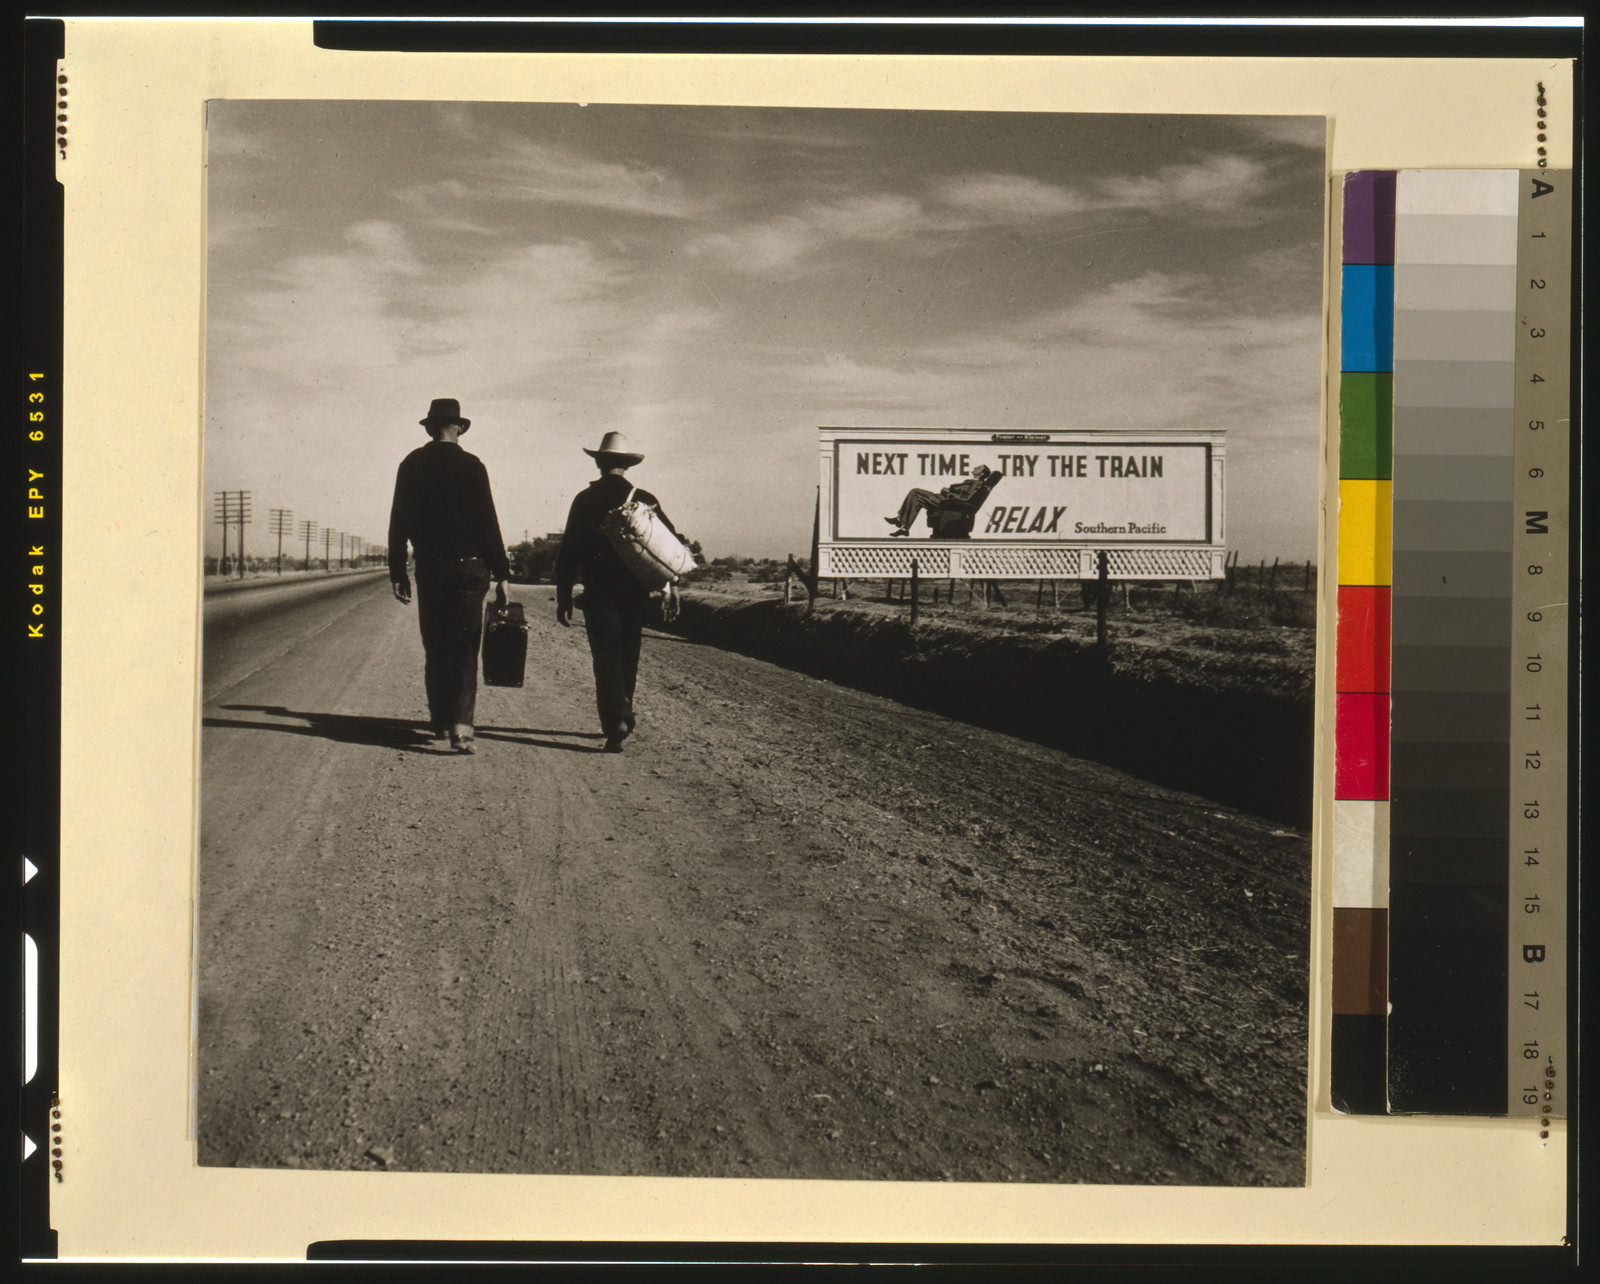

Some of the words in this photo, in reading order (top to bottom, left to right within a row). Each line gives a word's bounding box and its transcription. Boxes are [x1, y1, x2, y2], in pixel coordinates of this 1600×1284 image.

[1530, 178, 1554, 199] A
[1530, 279, 1546, 289] 2
[1530, 328, 1545, 338] 3
[1529, 374, 1545, 384] 4
[28, 374, 45, 441] 6531
[1529, 421, 1544, 431] 5
[857, 453, 908, 476] NEXT
[917, 453, 970, 476] TIME
[998, 455, 1039, 477] TRY
[1047, 455, 1088, 477] THE
[1096, 456, 1162, 478] TRAIN
[1529, 468, 1544, 478] 6
[28, 469, 44, 519] EPY
[984, 506, 1067, 534] RELAX
[1075, 521, 1126, 534] Southern
[1128, 521, 1166, 534] Pacific
[1526, 511, 1548, 534] M
[1528, 565, 1543, 575] 8
[28, 545, 44, 637] Kodak
[1527, 612, 1542, 622] 9
[1527, 653, 1542, 672] 10
[1526, 703, 1541, 720] 11
[1526, 750, 1541, 769] 12
[1524, 799, 1539, 819] 13
[1524, 847, 1539, 866] 14
[1524, 894, 1540, 913] 15
[1523, 945, 1545, 964] B
[1524, 991, 1539, 1010] 17
[1524, 1040, 1539, 1059] 18
[1523, 1085, 1538, 1104] 19
